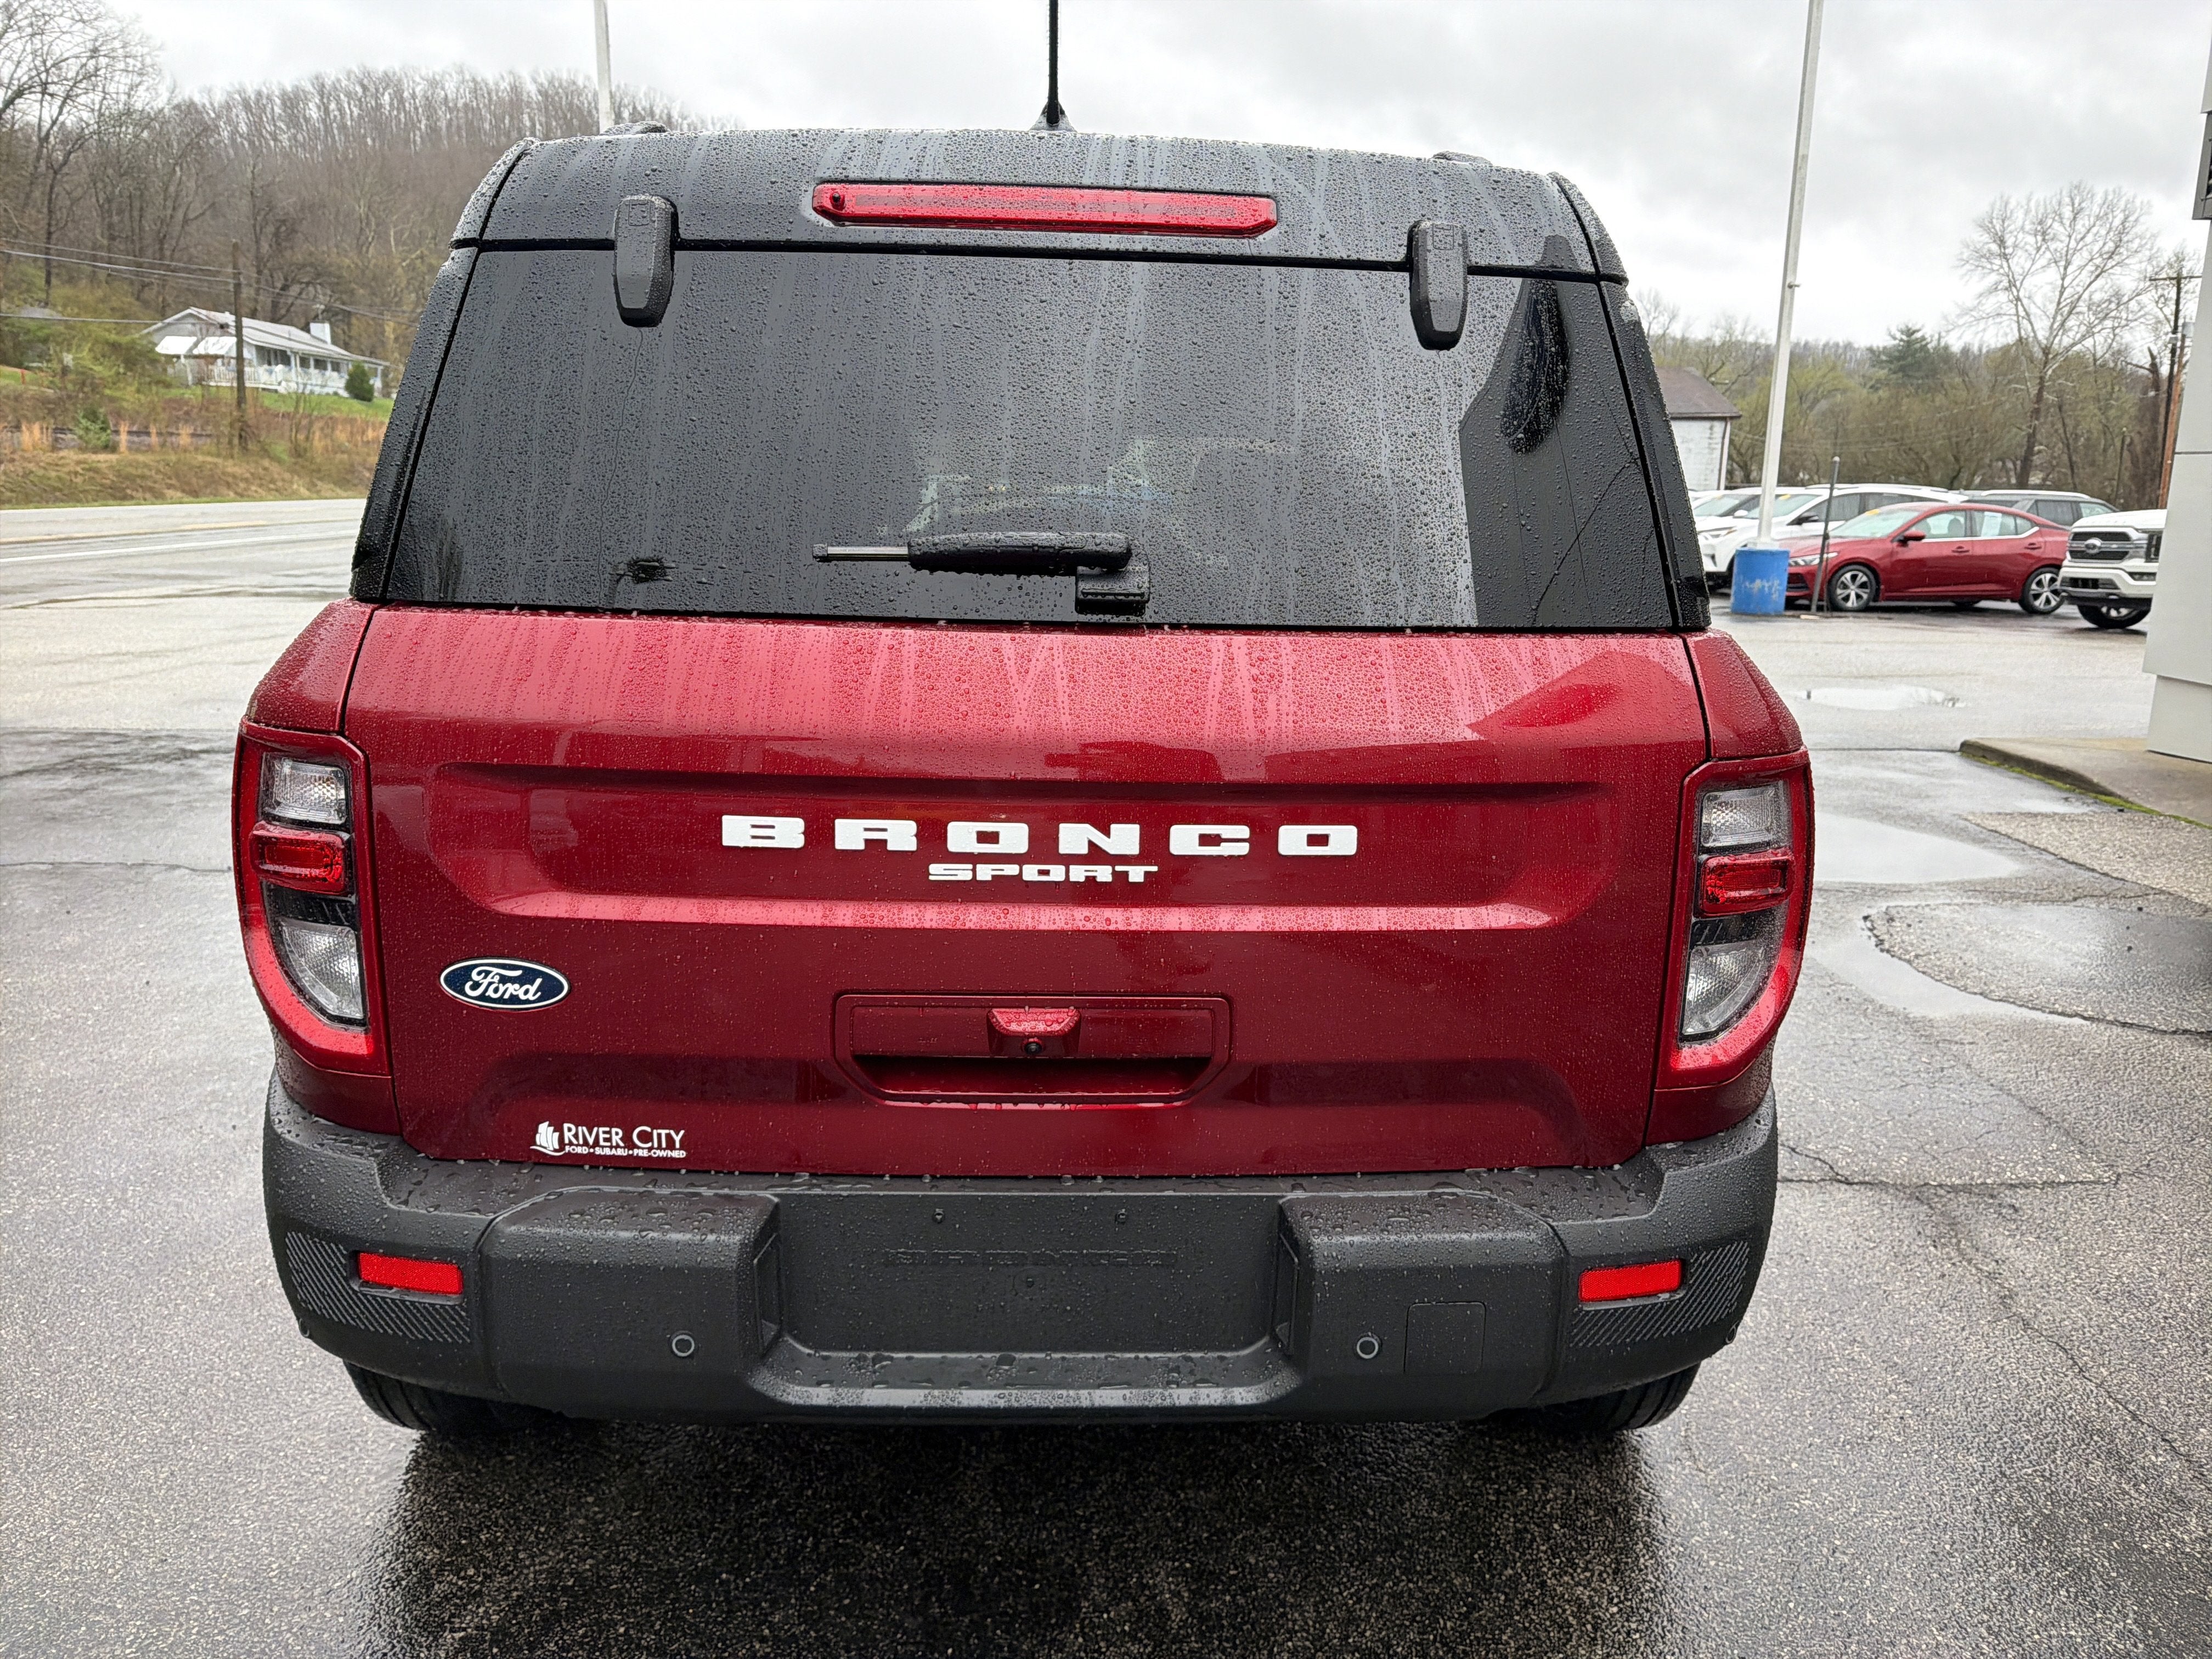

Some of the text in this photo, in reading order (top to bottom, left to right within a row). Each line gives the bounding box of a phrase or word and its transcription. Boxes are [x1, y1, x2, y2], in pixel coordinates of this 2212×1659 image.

[721, 814, 1358, 857] BRONCO
[928, 863, 1159, 883] SPORT
[464, 966, 543, 1001] Ford
[562, 1122, 685, 1149] RIVER CITY
[565, 1145, 687, 1159] FORD SUBARU PRE-OWNED
